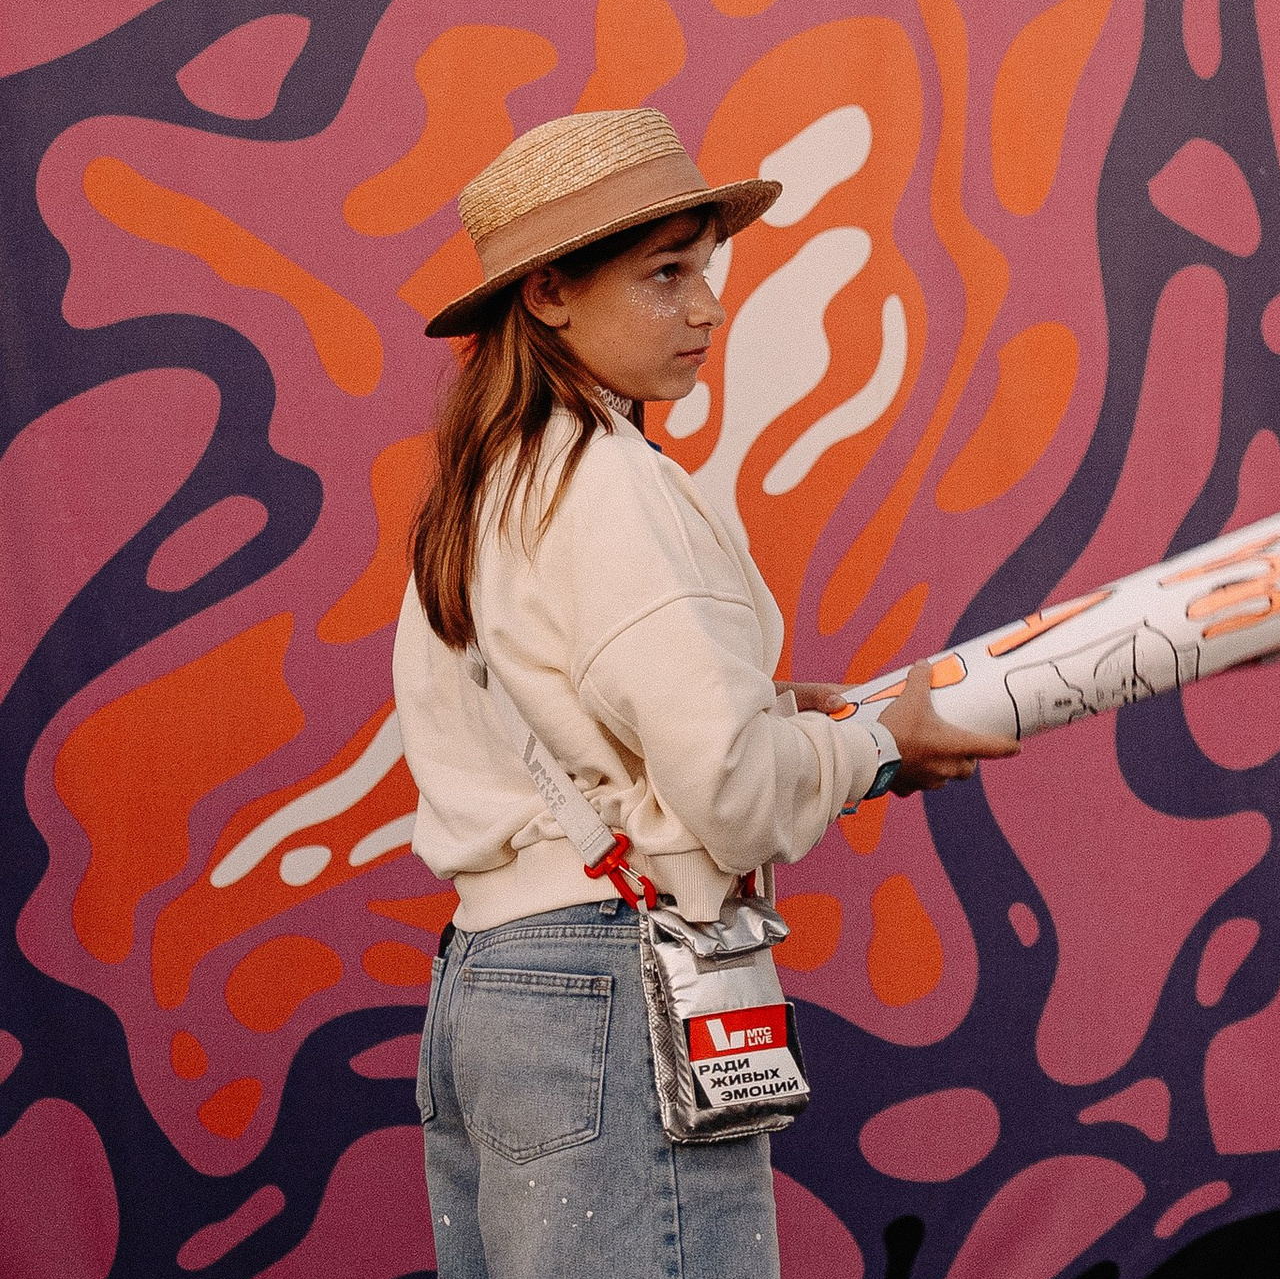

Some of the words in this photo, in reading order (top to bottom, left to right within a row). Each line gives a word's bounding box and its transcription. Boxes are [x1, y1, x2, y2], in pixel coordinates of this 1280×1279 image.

[747, 1035, 773, 1047] LIVE
[698, 1058, 750, 1075] РАДИ
[710, 1068, 781, 1089] ЖИВЫХ
[720, 1077, 800, 1102] ЭМОЦИЙ
